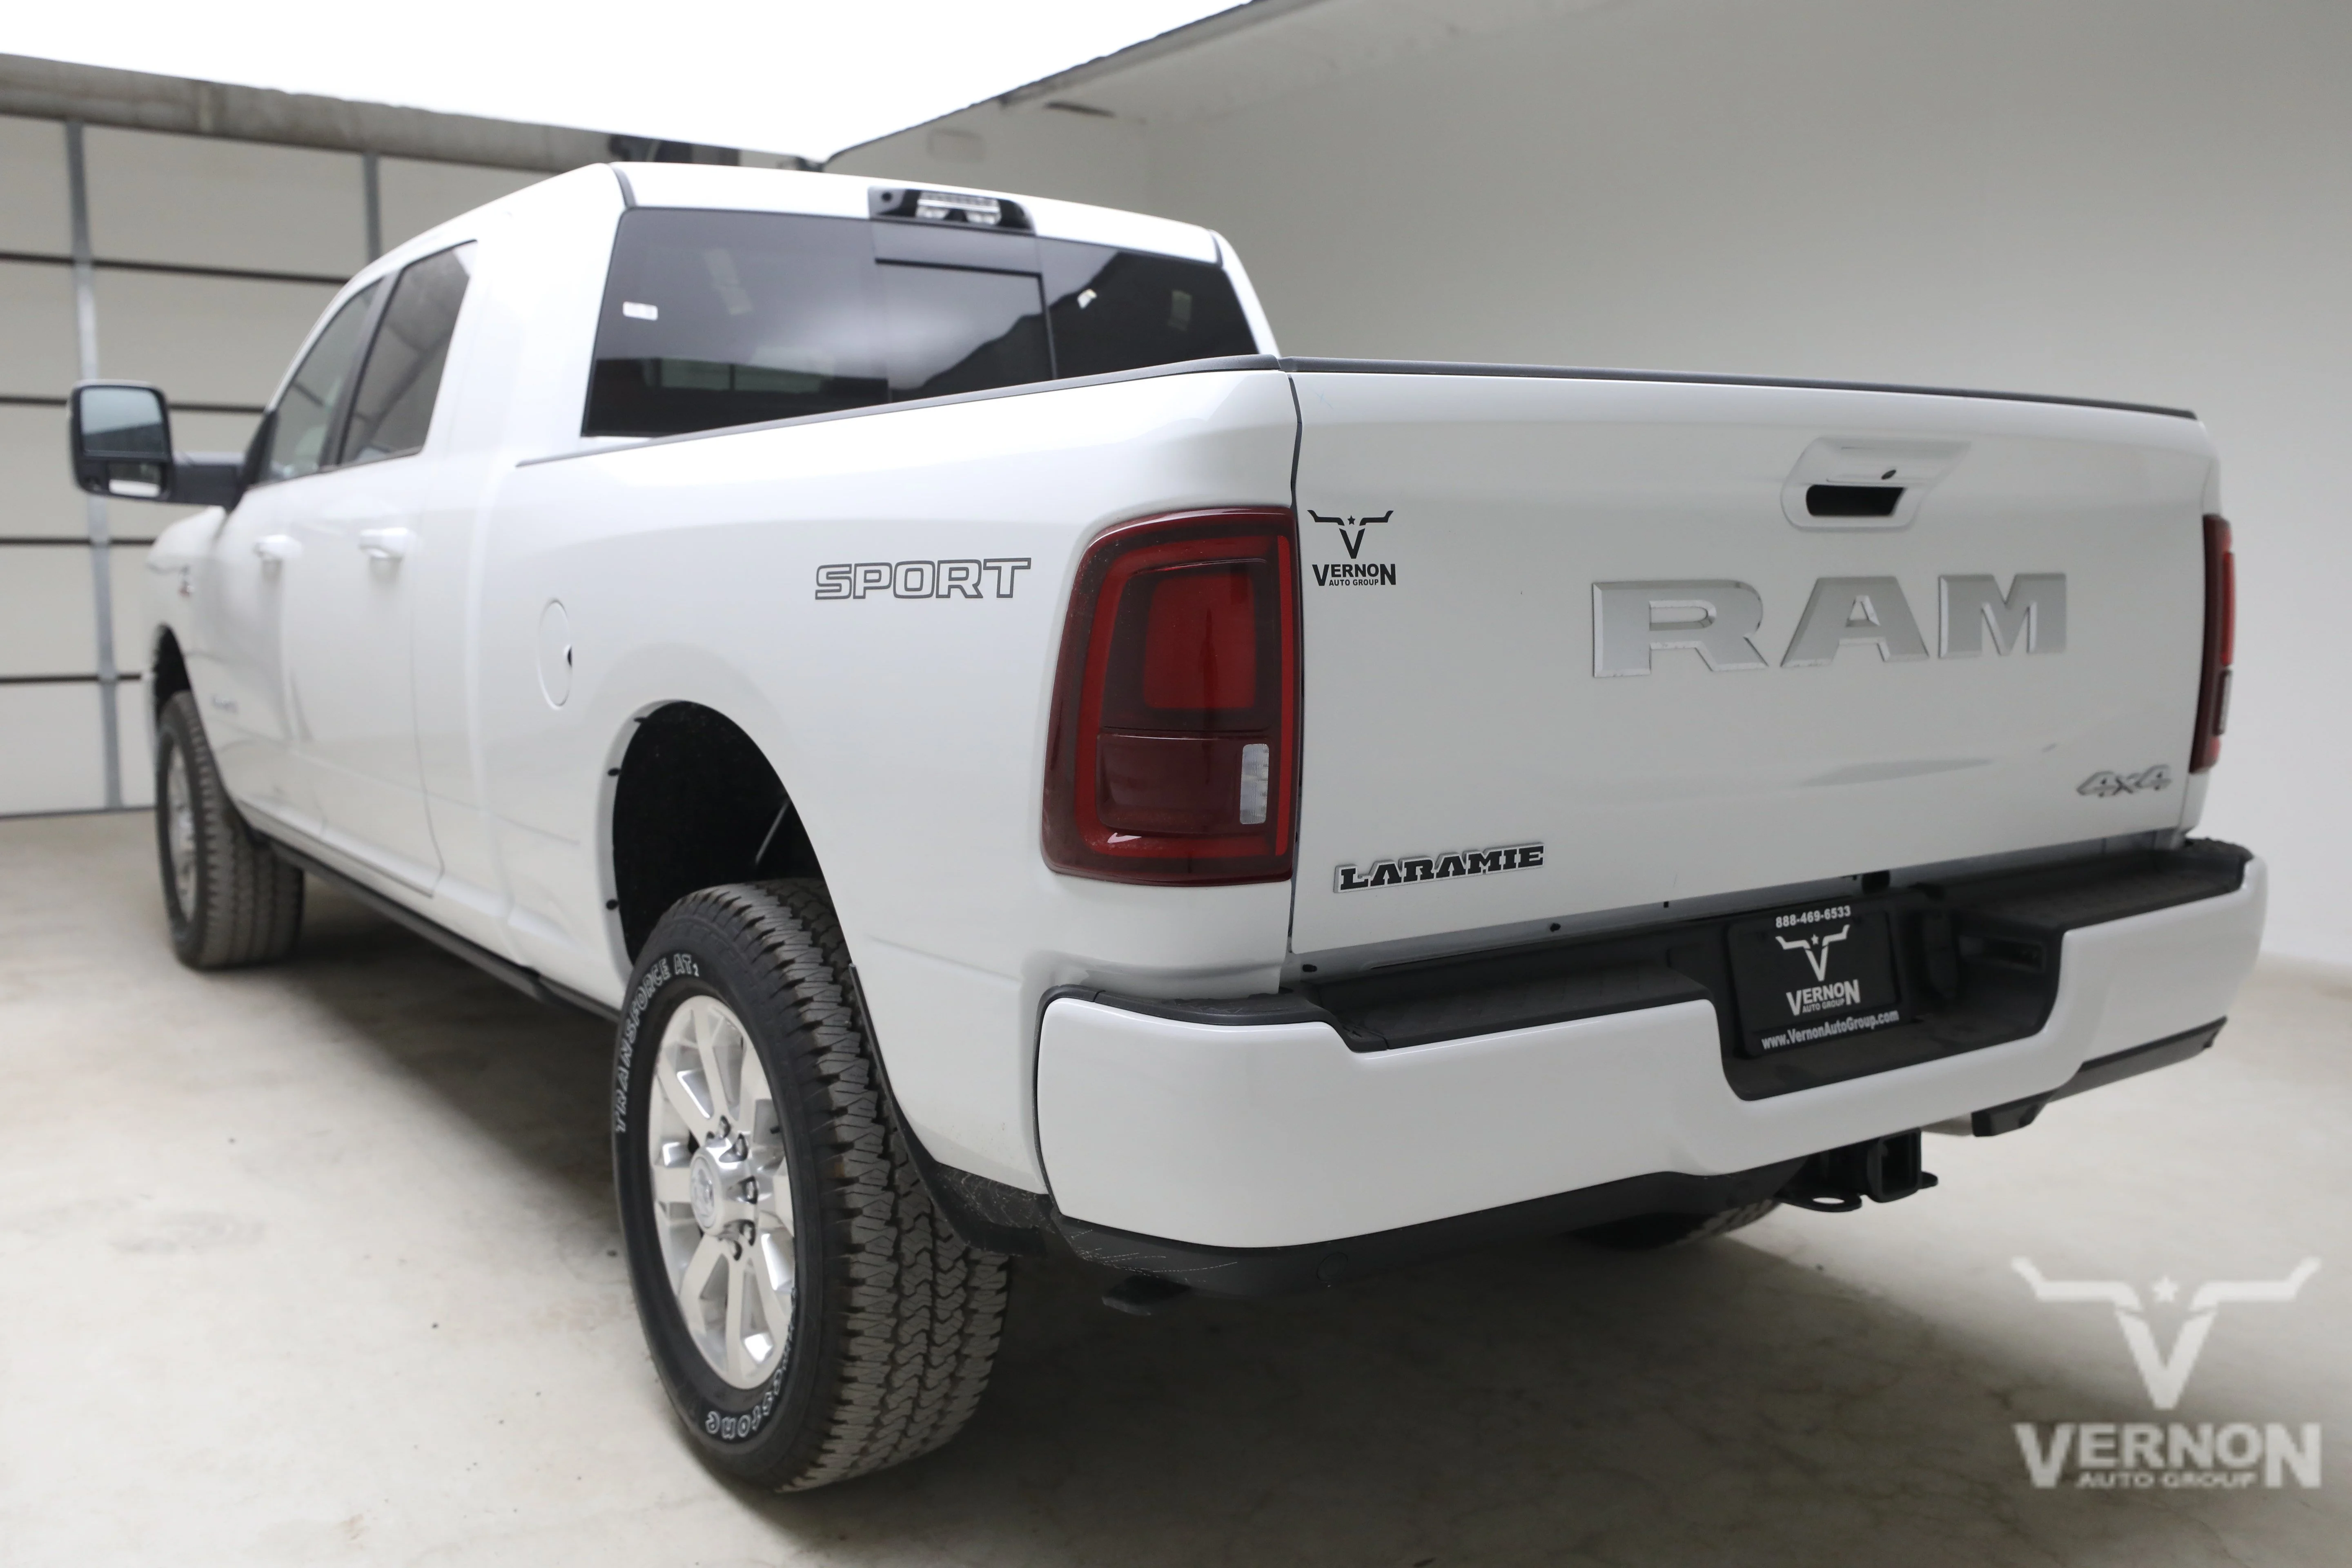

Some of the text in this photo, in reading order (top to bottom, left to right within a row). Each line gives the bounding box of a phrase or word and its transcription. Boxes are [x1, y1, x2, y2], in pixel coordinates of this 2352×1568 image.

[815, 557, 1031, 600] SPORT
[1312, 563, 1396, 586] VERNON
[1591, 572, 2067, 678] RAM
[1334, 842, 1545, 893] LARAMIE
[1775, 905, 1851, 929] 888-469-6533
[1786, 979, 1861, 1016] VERNON
[1802, 998, 1845, 1013] AUTO GROUP
[615, 957, 672, 1133] TRANSFORCE
[1761, 1010, 1900, 1051] www.VernonAutoGroup.com
